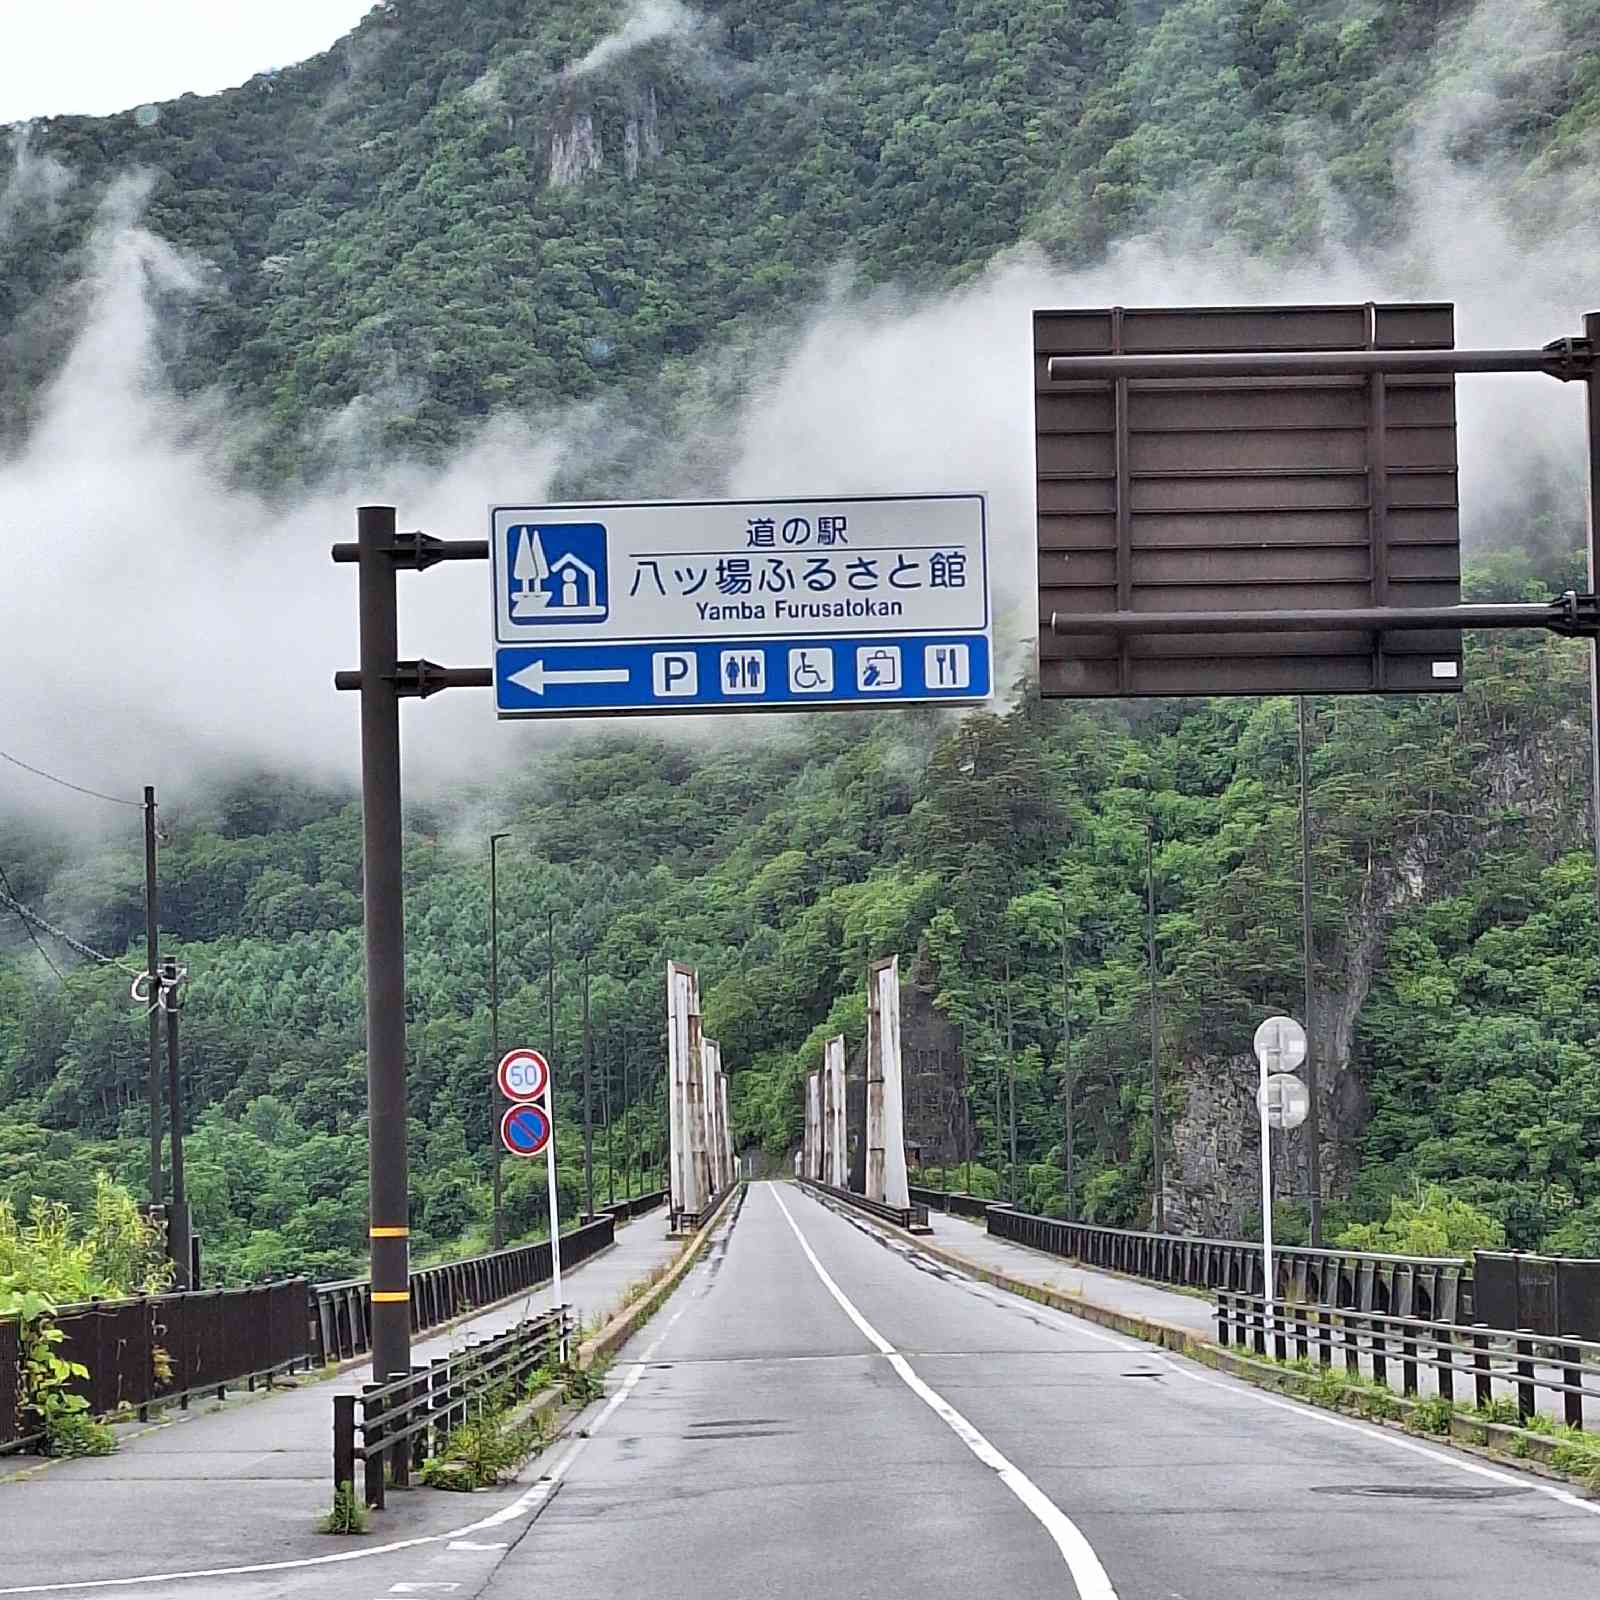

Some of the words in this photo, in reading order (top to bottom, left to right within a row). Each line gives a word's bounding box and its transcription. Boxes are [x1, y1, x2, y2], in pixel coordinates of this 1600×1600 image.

[746, 516, 848, 548] 道の駅
[696, 601, 766, 621] Yamba
[774, 598, 903, 619] Furusatokan
[663, 657, 689, 692] P
[510, 1065, 537, 1086] 50
